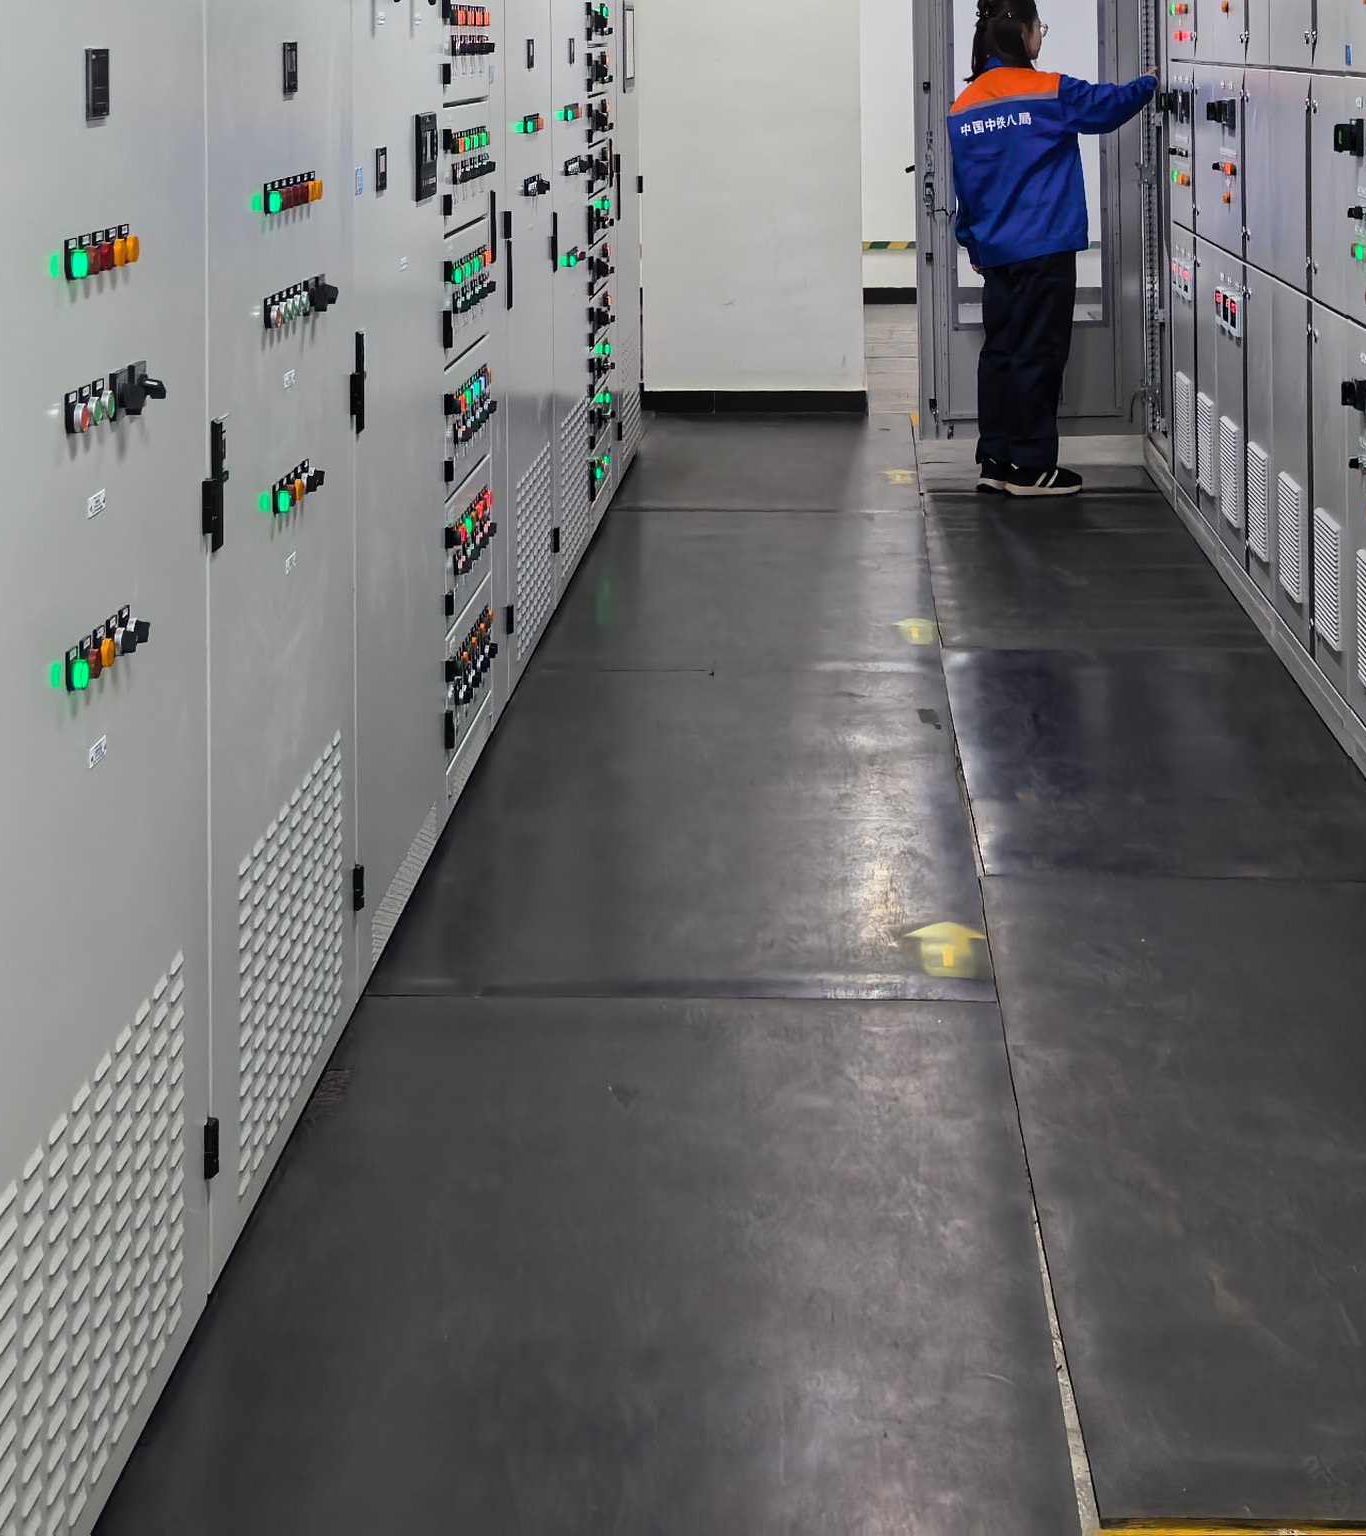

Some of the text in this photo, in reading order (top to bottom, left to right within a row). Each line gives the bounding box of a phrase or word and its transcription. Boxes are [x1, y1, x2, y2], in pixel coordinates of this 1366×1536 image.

[960, 111, 1032, 137] 中国中铁八局
